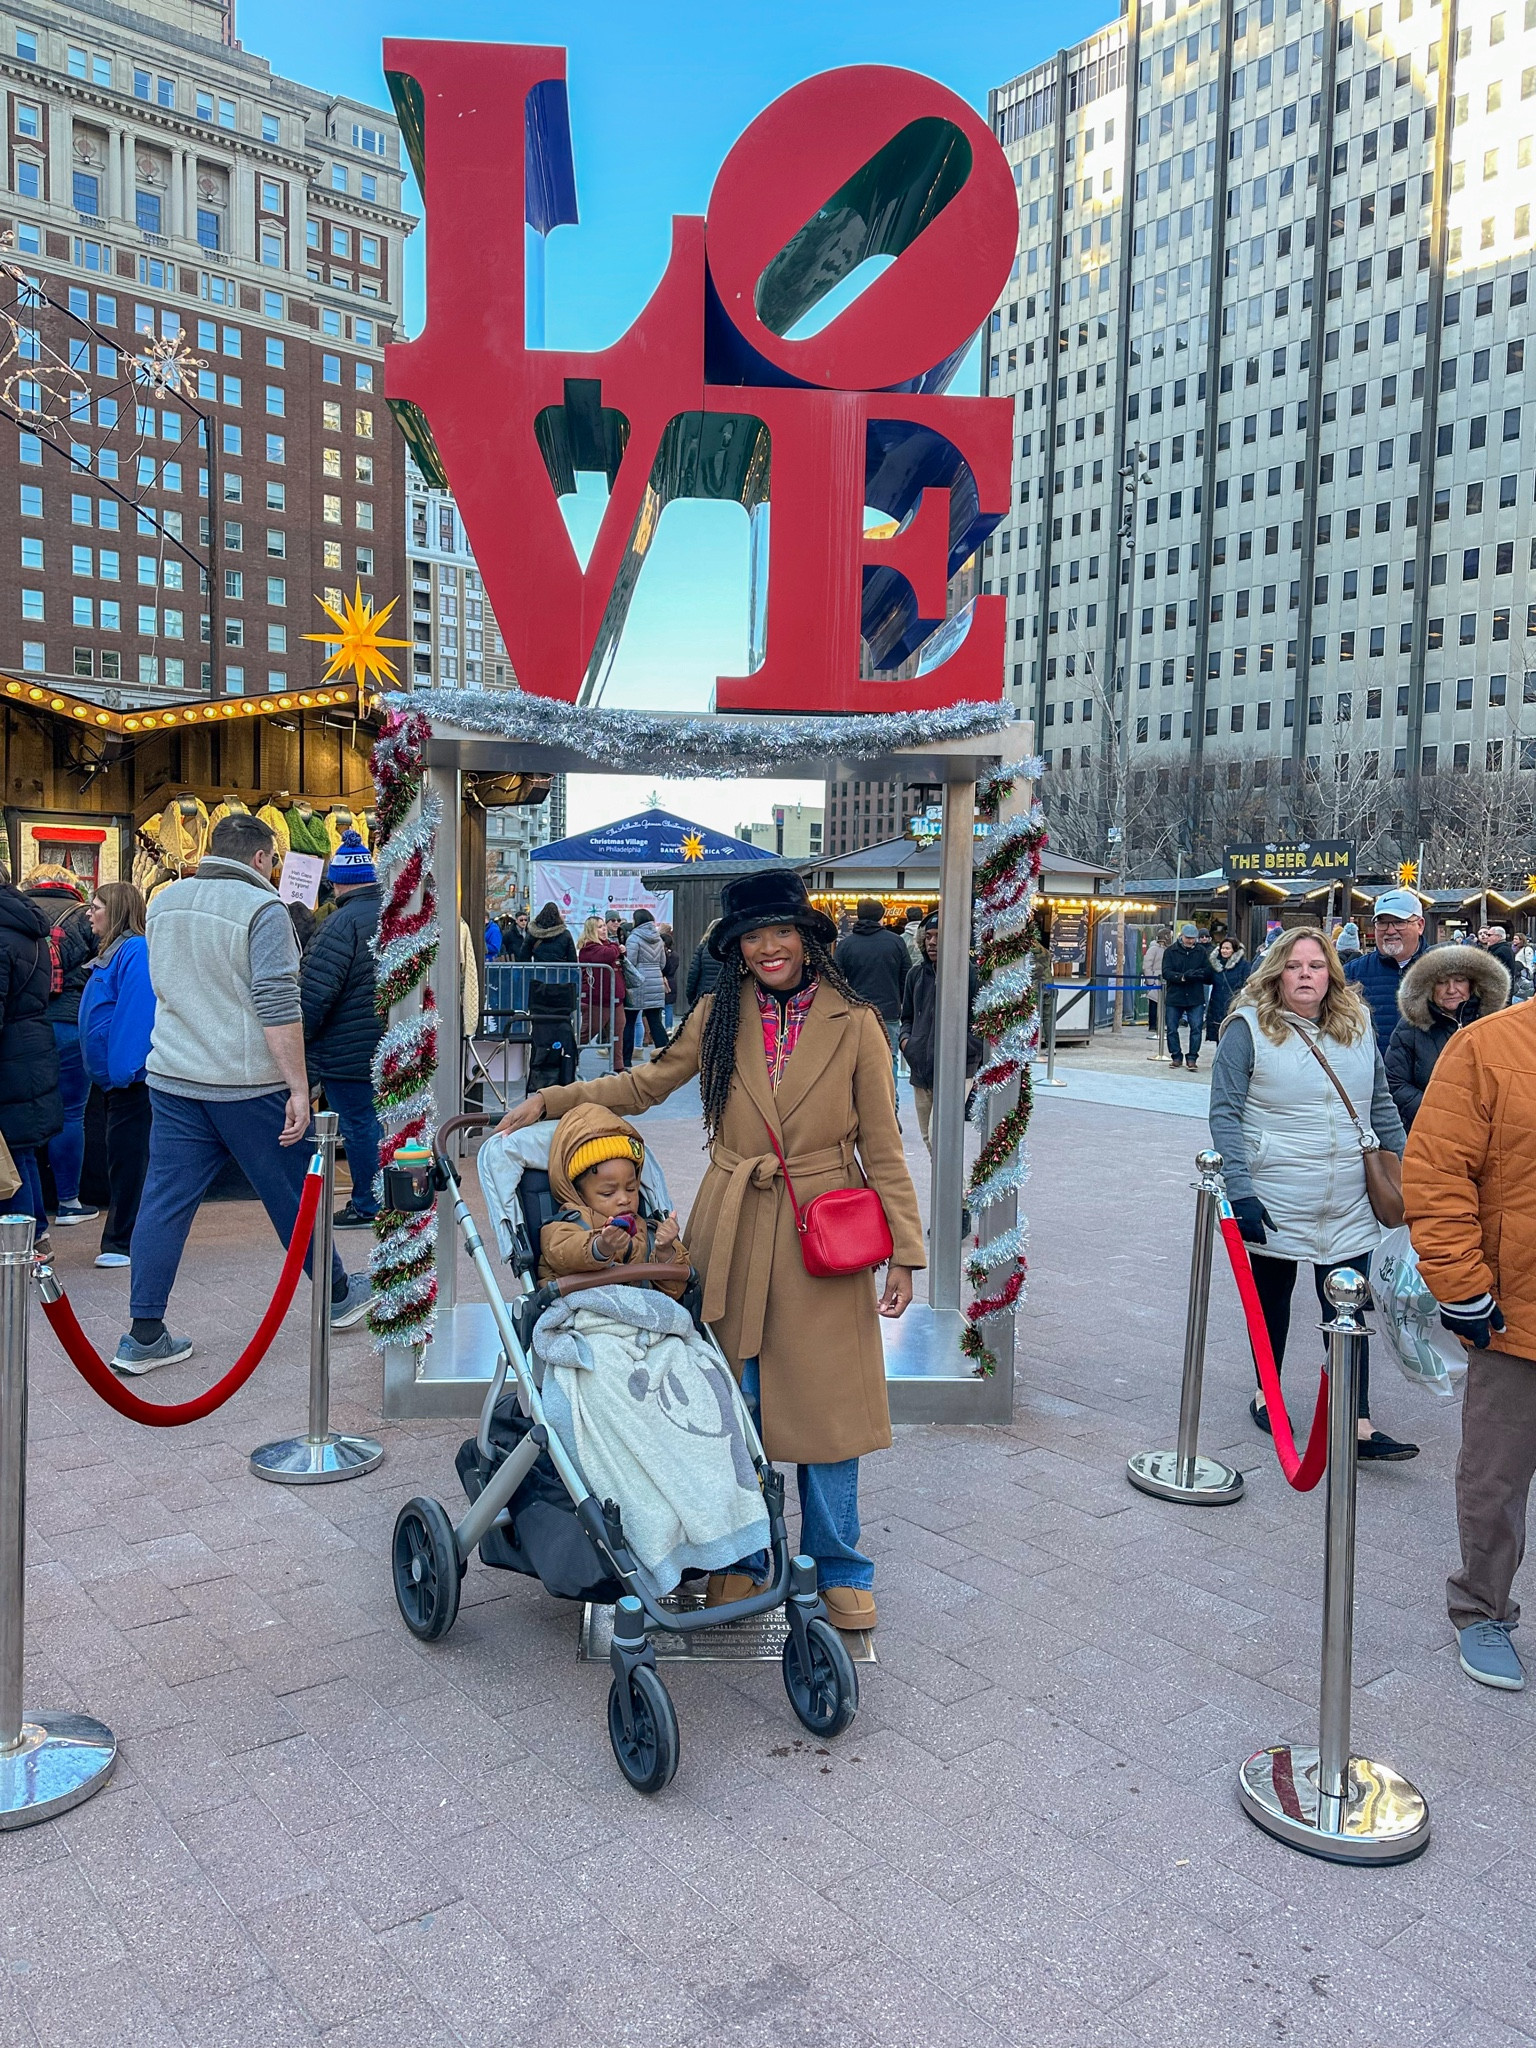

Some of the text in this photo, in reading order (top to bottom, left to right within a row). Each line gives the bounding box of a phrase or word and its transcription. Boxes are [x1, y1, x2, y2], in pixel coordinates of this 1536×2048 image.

[589, 837, 649, 846] Christmas Village
[605, 846, 642, 854] Philadelphia
[1229, 851, 1349, 869] THE BEER ALM
[884, 905, 904, 917] rder
